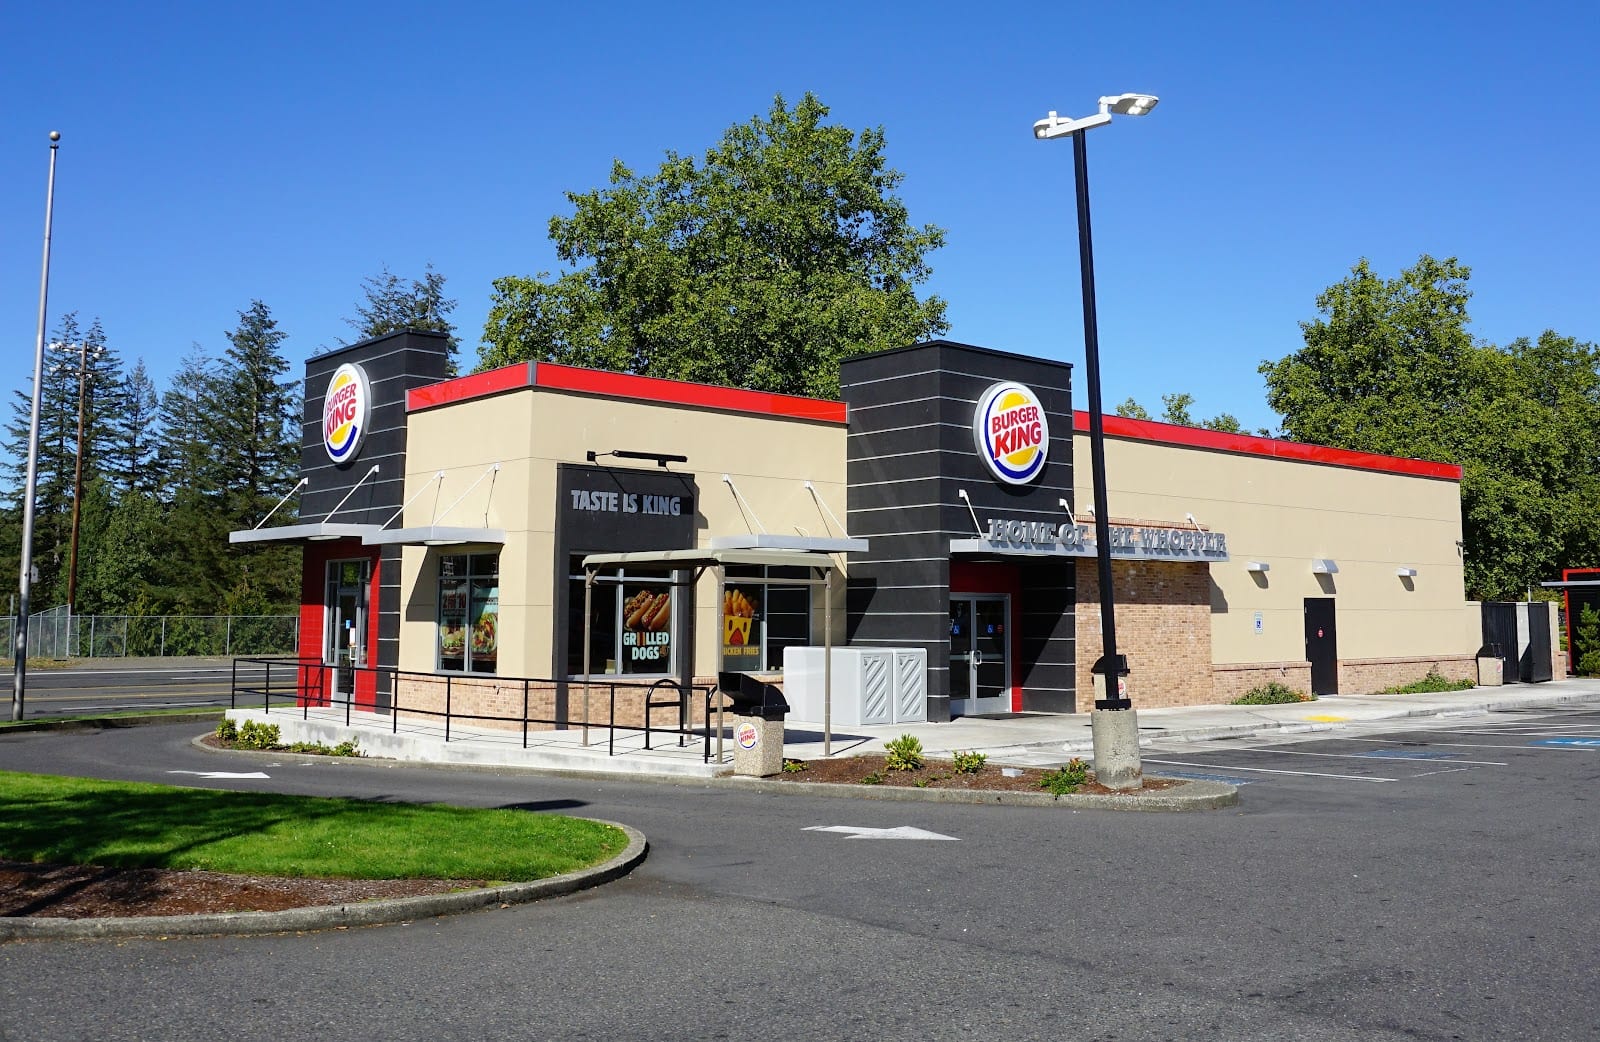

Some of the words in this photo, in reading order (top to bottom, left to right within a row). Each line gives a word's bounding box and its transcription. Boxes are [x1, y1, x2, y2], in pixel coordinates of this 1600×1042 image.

[326, 384, 357, 417] BURGER
[325, 398, 357, 441] KING
[992, 406, 1039, 435] BURGER
[994, 422, 1042, 459] KING
[570, 489, 619, 512] TASTE
[622, 493, 639, 513] IS
[642, 494, 681, 516] KING
[988, 519, 1057, 544] HOME
[1059, 524, 1089, 545] OF
[1108, 527, 1134, 547] HE
[1138, 528, 1226, 551] WHOPPER
[623, 631, 670, 646] GRILLED
[722, 646, 742, 656] ICKEN
[743, 646, 760, 656] FRIES
[631, 646, 660, 660] DOGS
[740, 733, 756, 743] KING
